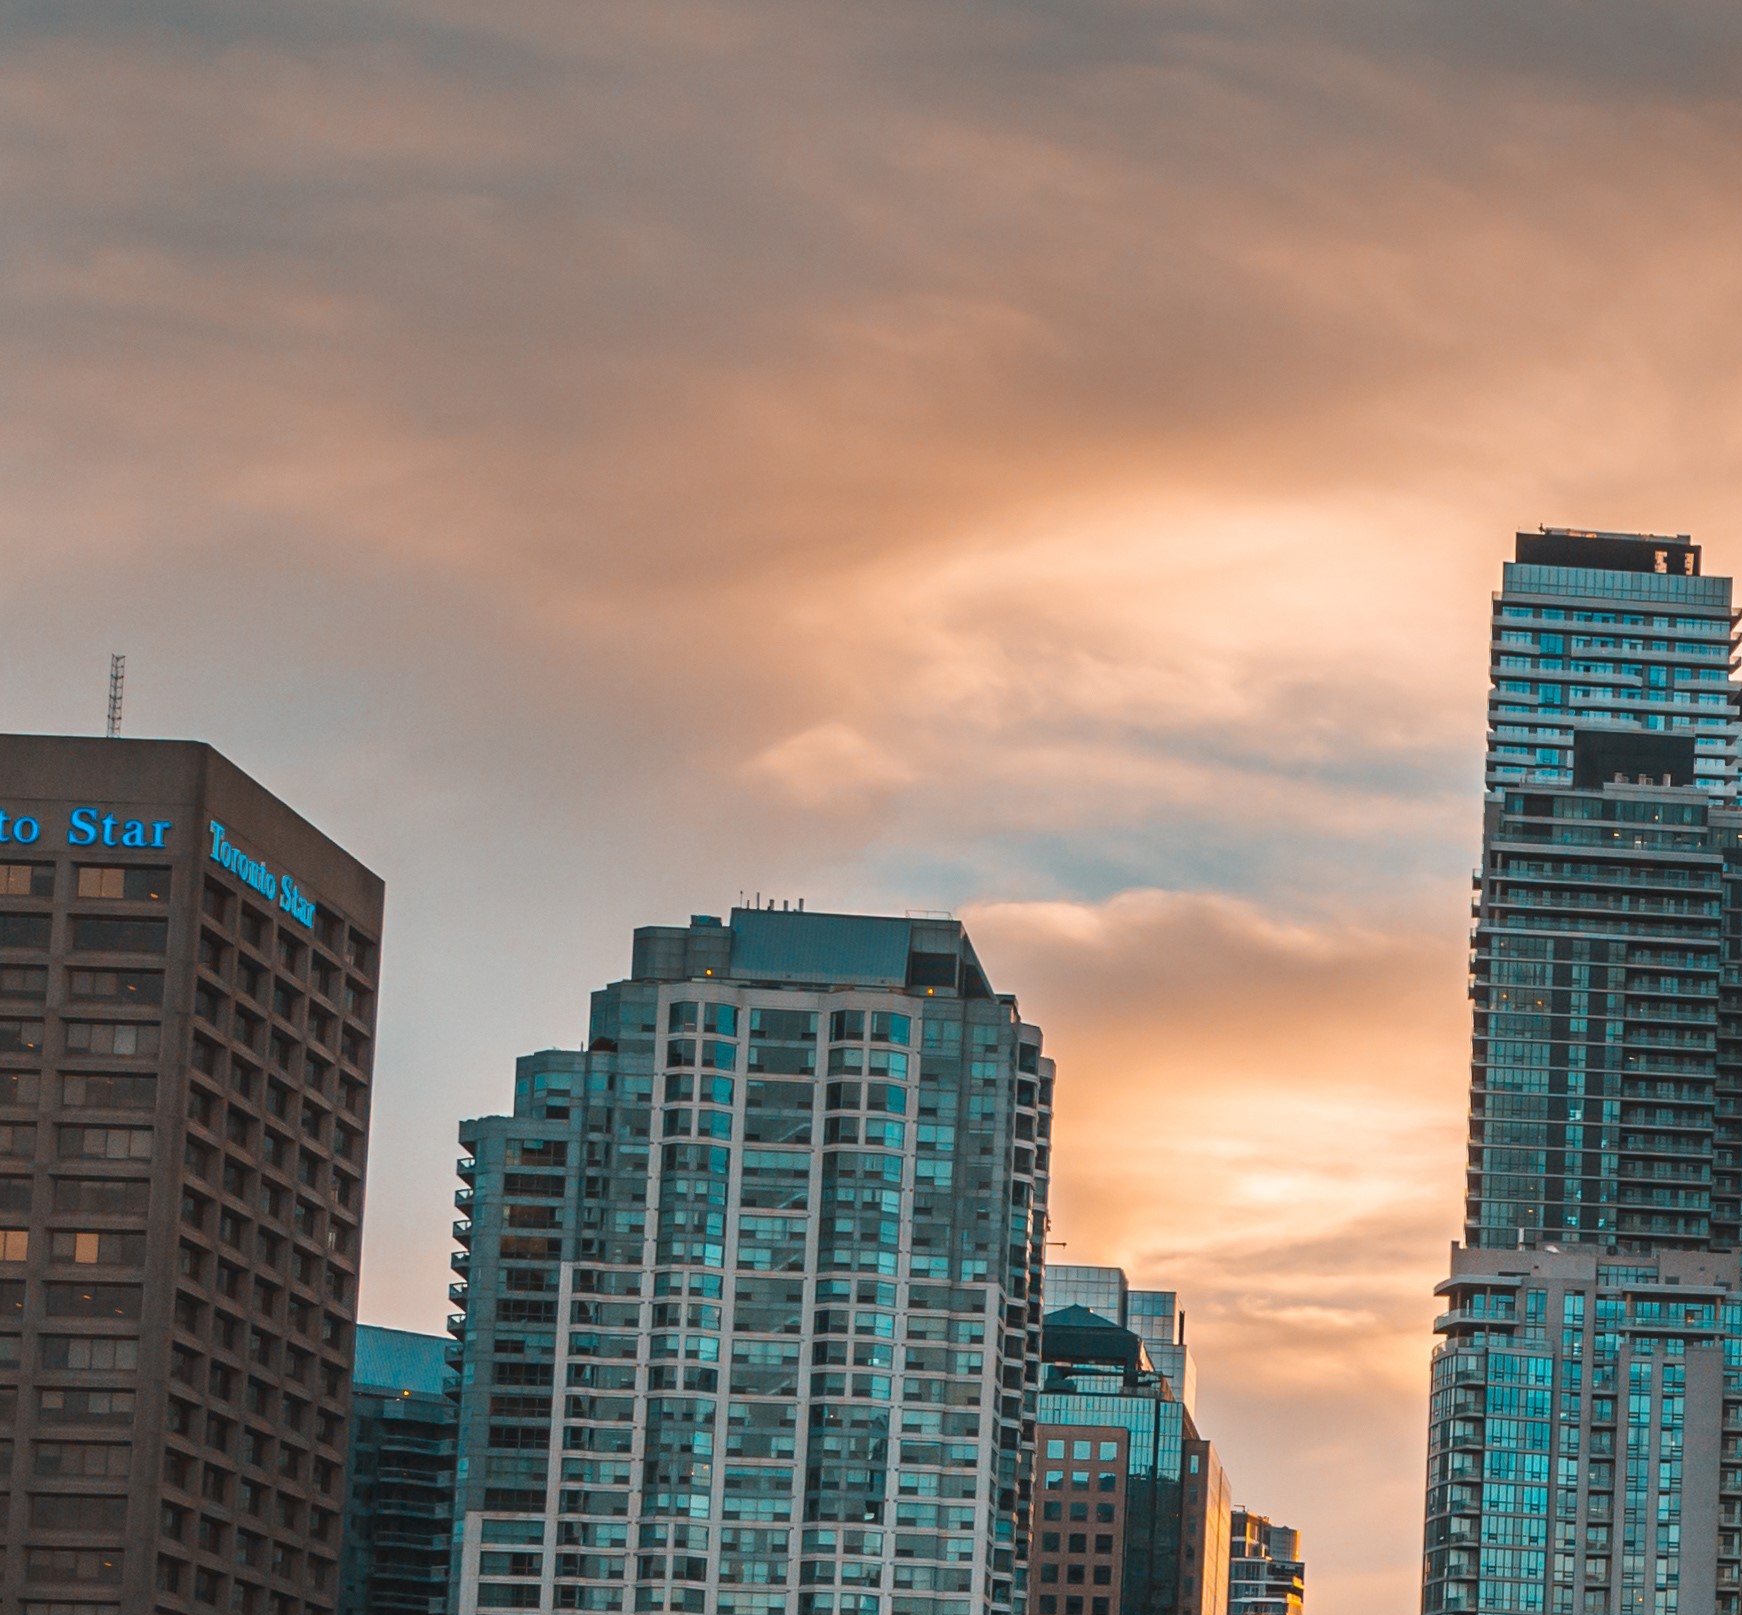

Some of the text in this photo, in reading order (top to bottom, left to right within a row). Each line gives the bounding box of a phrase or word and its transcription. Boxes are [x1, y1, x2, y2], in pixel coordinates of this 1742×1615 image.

[67, 806, 172, 848] Star
[210, 820, 316, 929] Toronto Star
